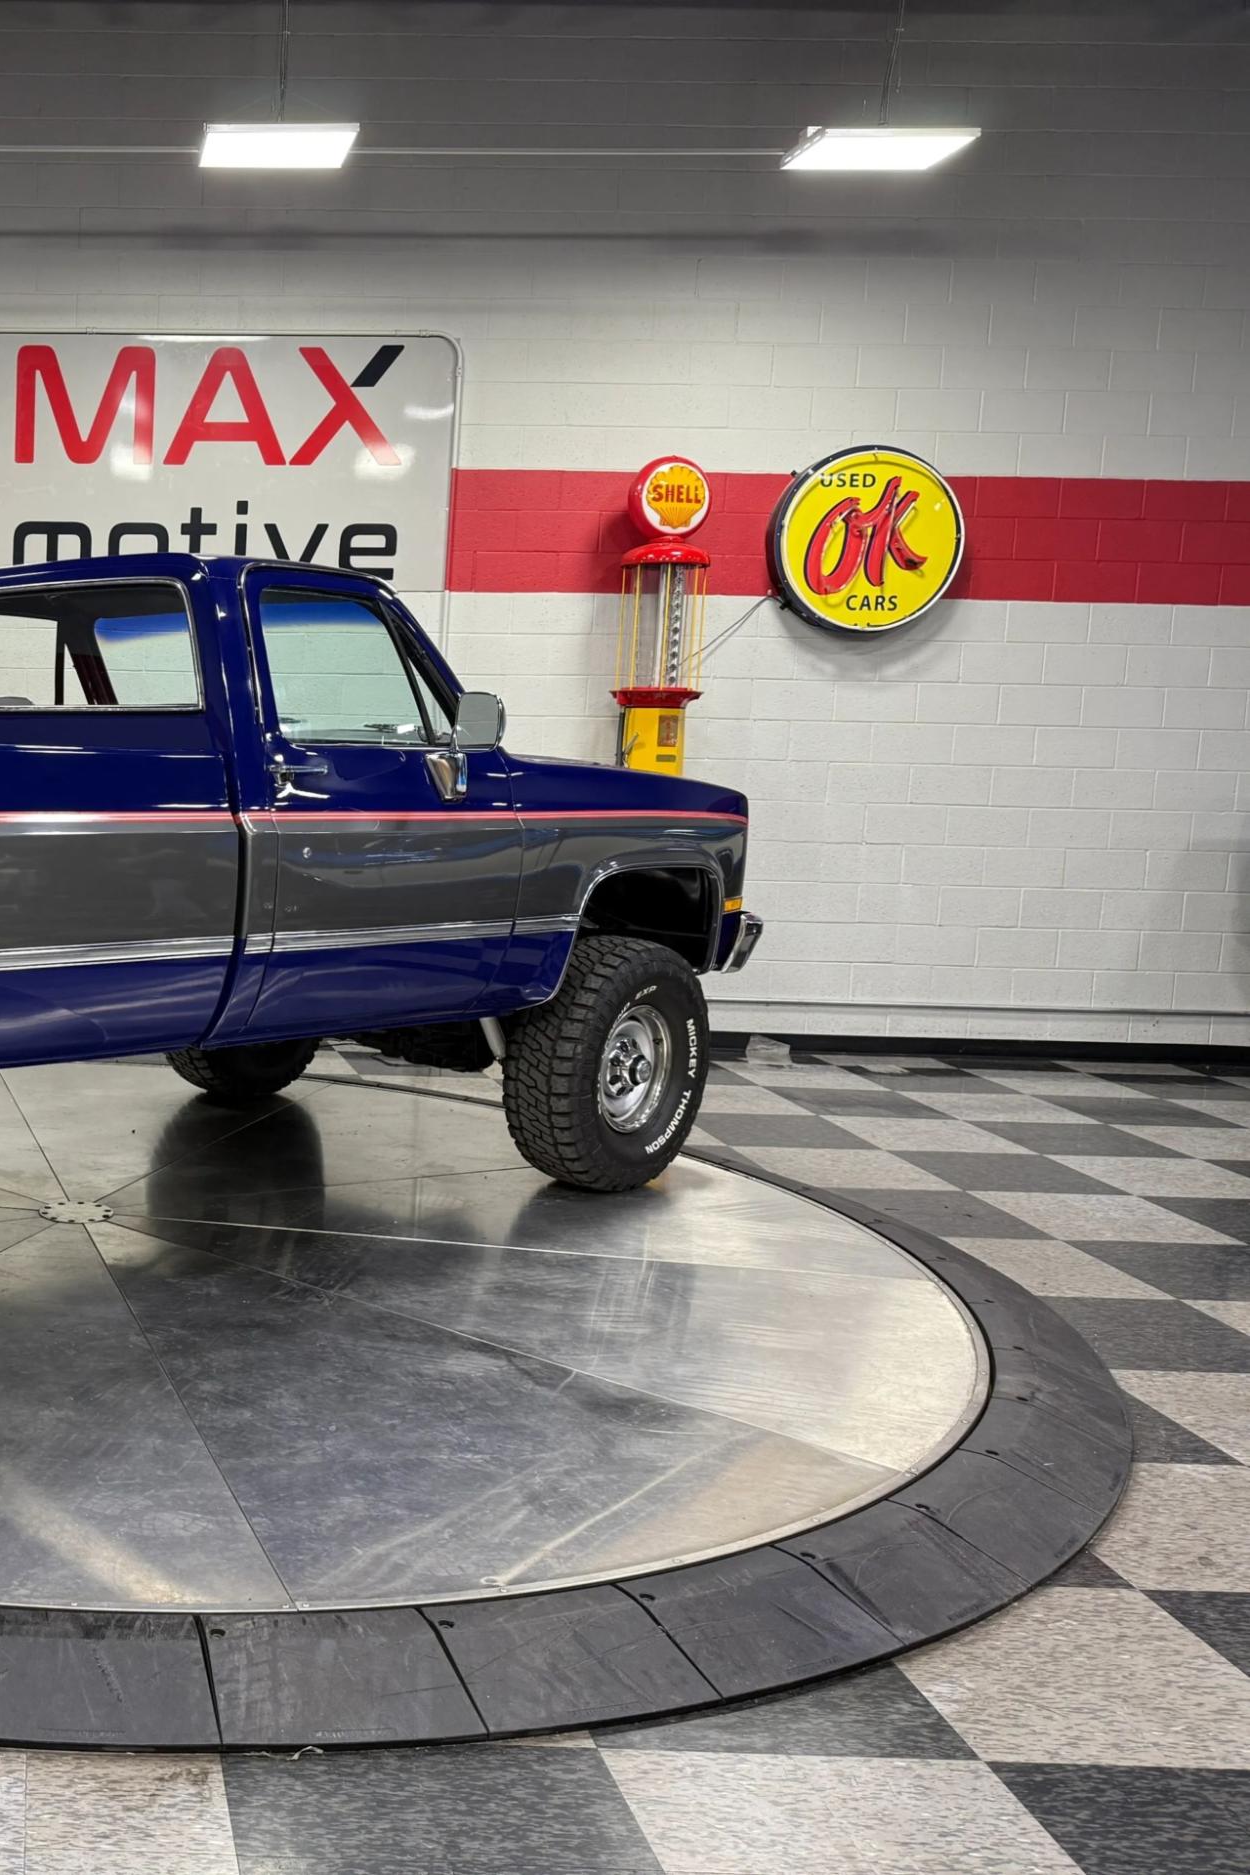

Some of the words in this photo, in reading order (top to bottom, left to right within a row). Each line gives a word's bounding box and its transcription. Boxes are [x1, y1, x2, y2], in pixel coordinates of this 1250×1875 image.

[14, 344, 405, 465] MAX
[651, 483, 702, 505] SHELL
[820, 473, 876, 488] USED
[13, 500, 398, 580] motive
[846, 595, 898, 611] CARS
[686, 1018, 698, 1078] MICKEY
[644, 1090, 693, 1154] THOMPSON
